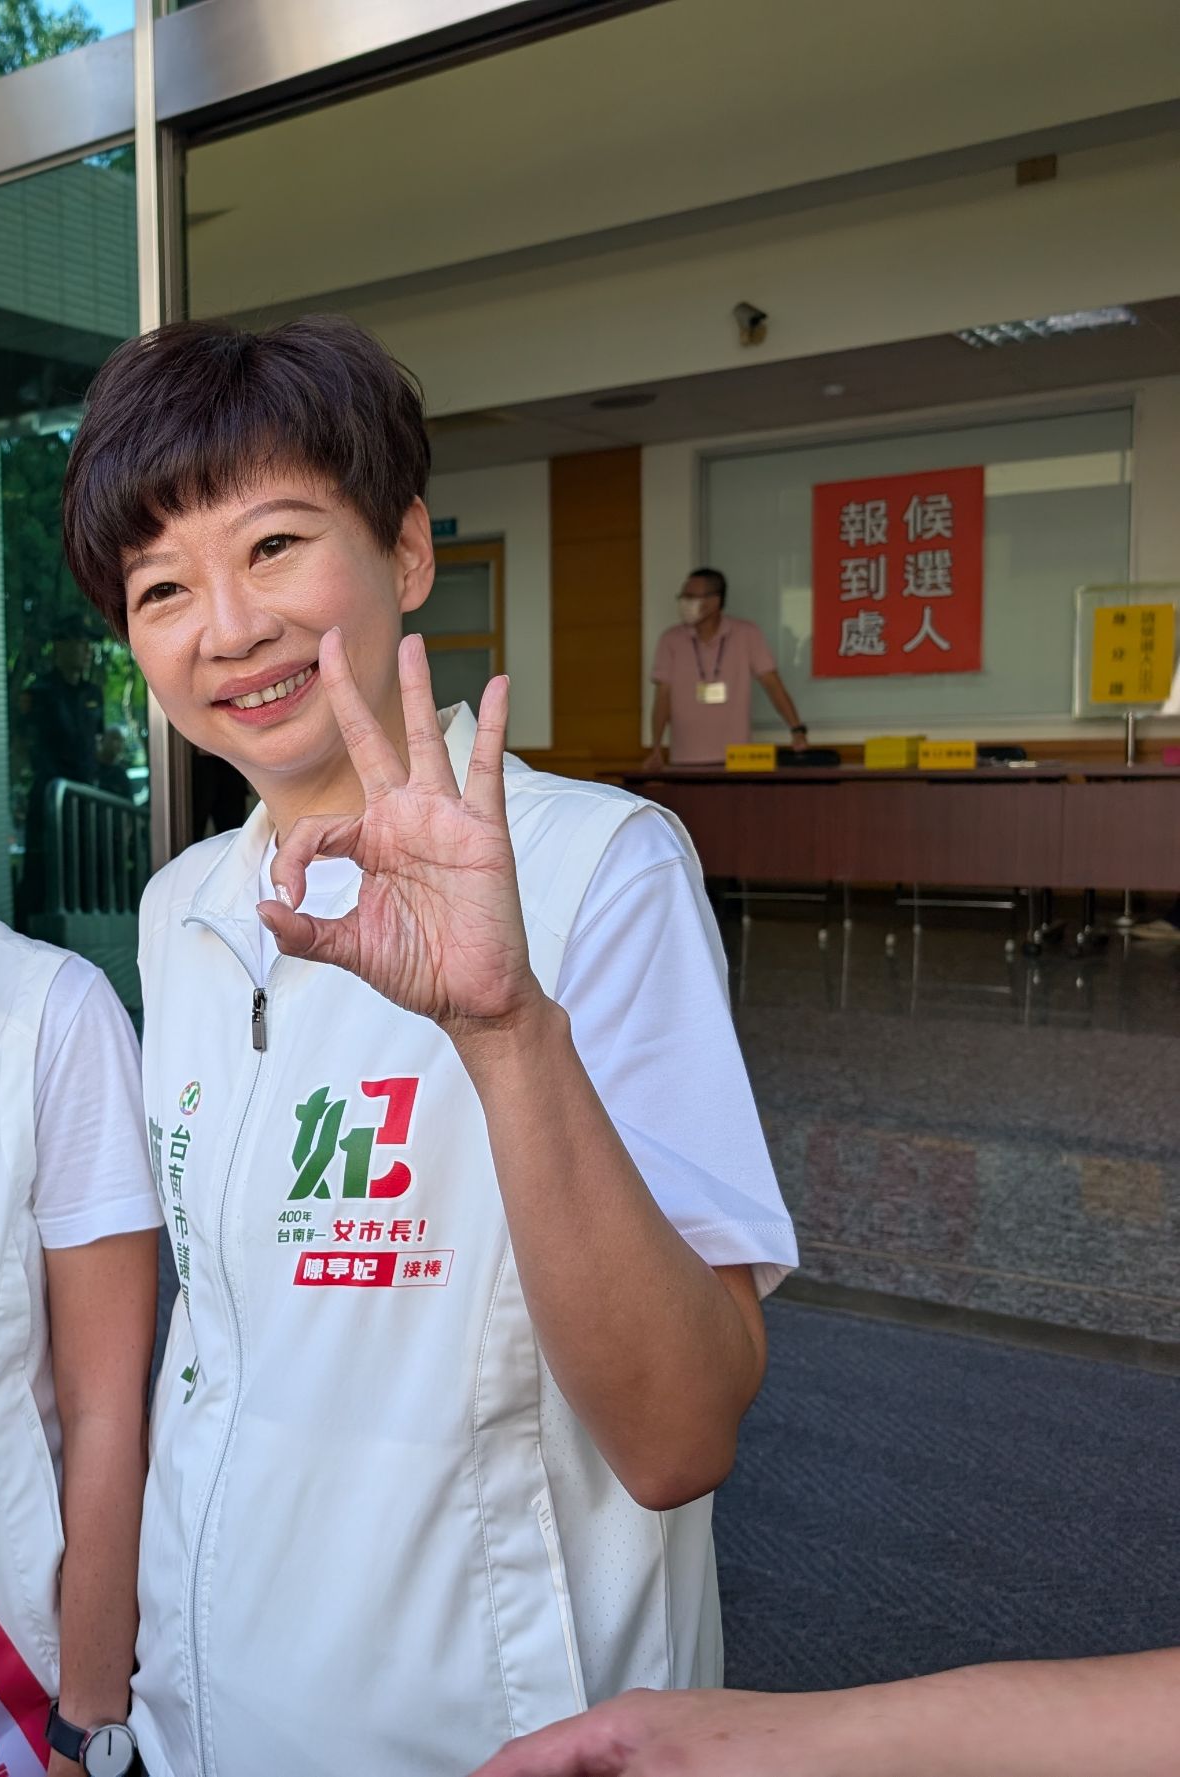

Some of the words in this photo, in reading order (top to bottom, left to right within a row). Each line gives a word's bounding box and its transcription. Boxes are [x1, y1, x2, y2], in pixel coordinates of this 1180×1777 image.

[838, 498, 889, 657] 報到處
[903, 493, 954, 653] 候選人
[277, 1210, 312, 1223] 400年
[302, 1257, 378, 1281] 陳亭妃
[402, 1259, 442, 1279] 接棒
